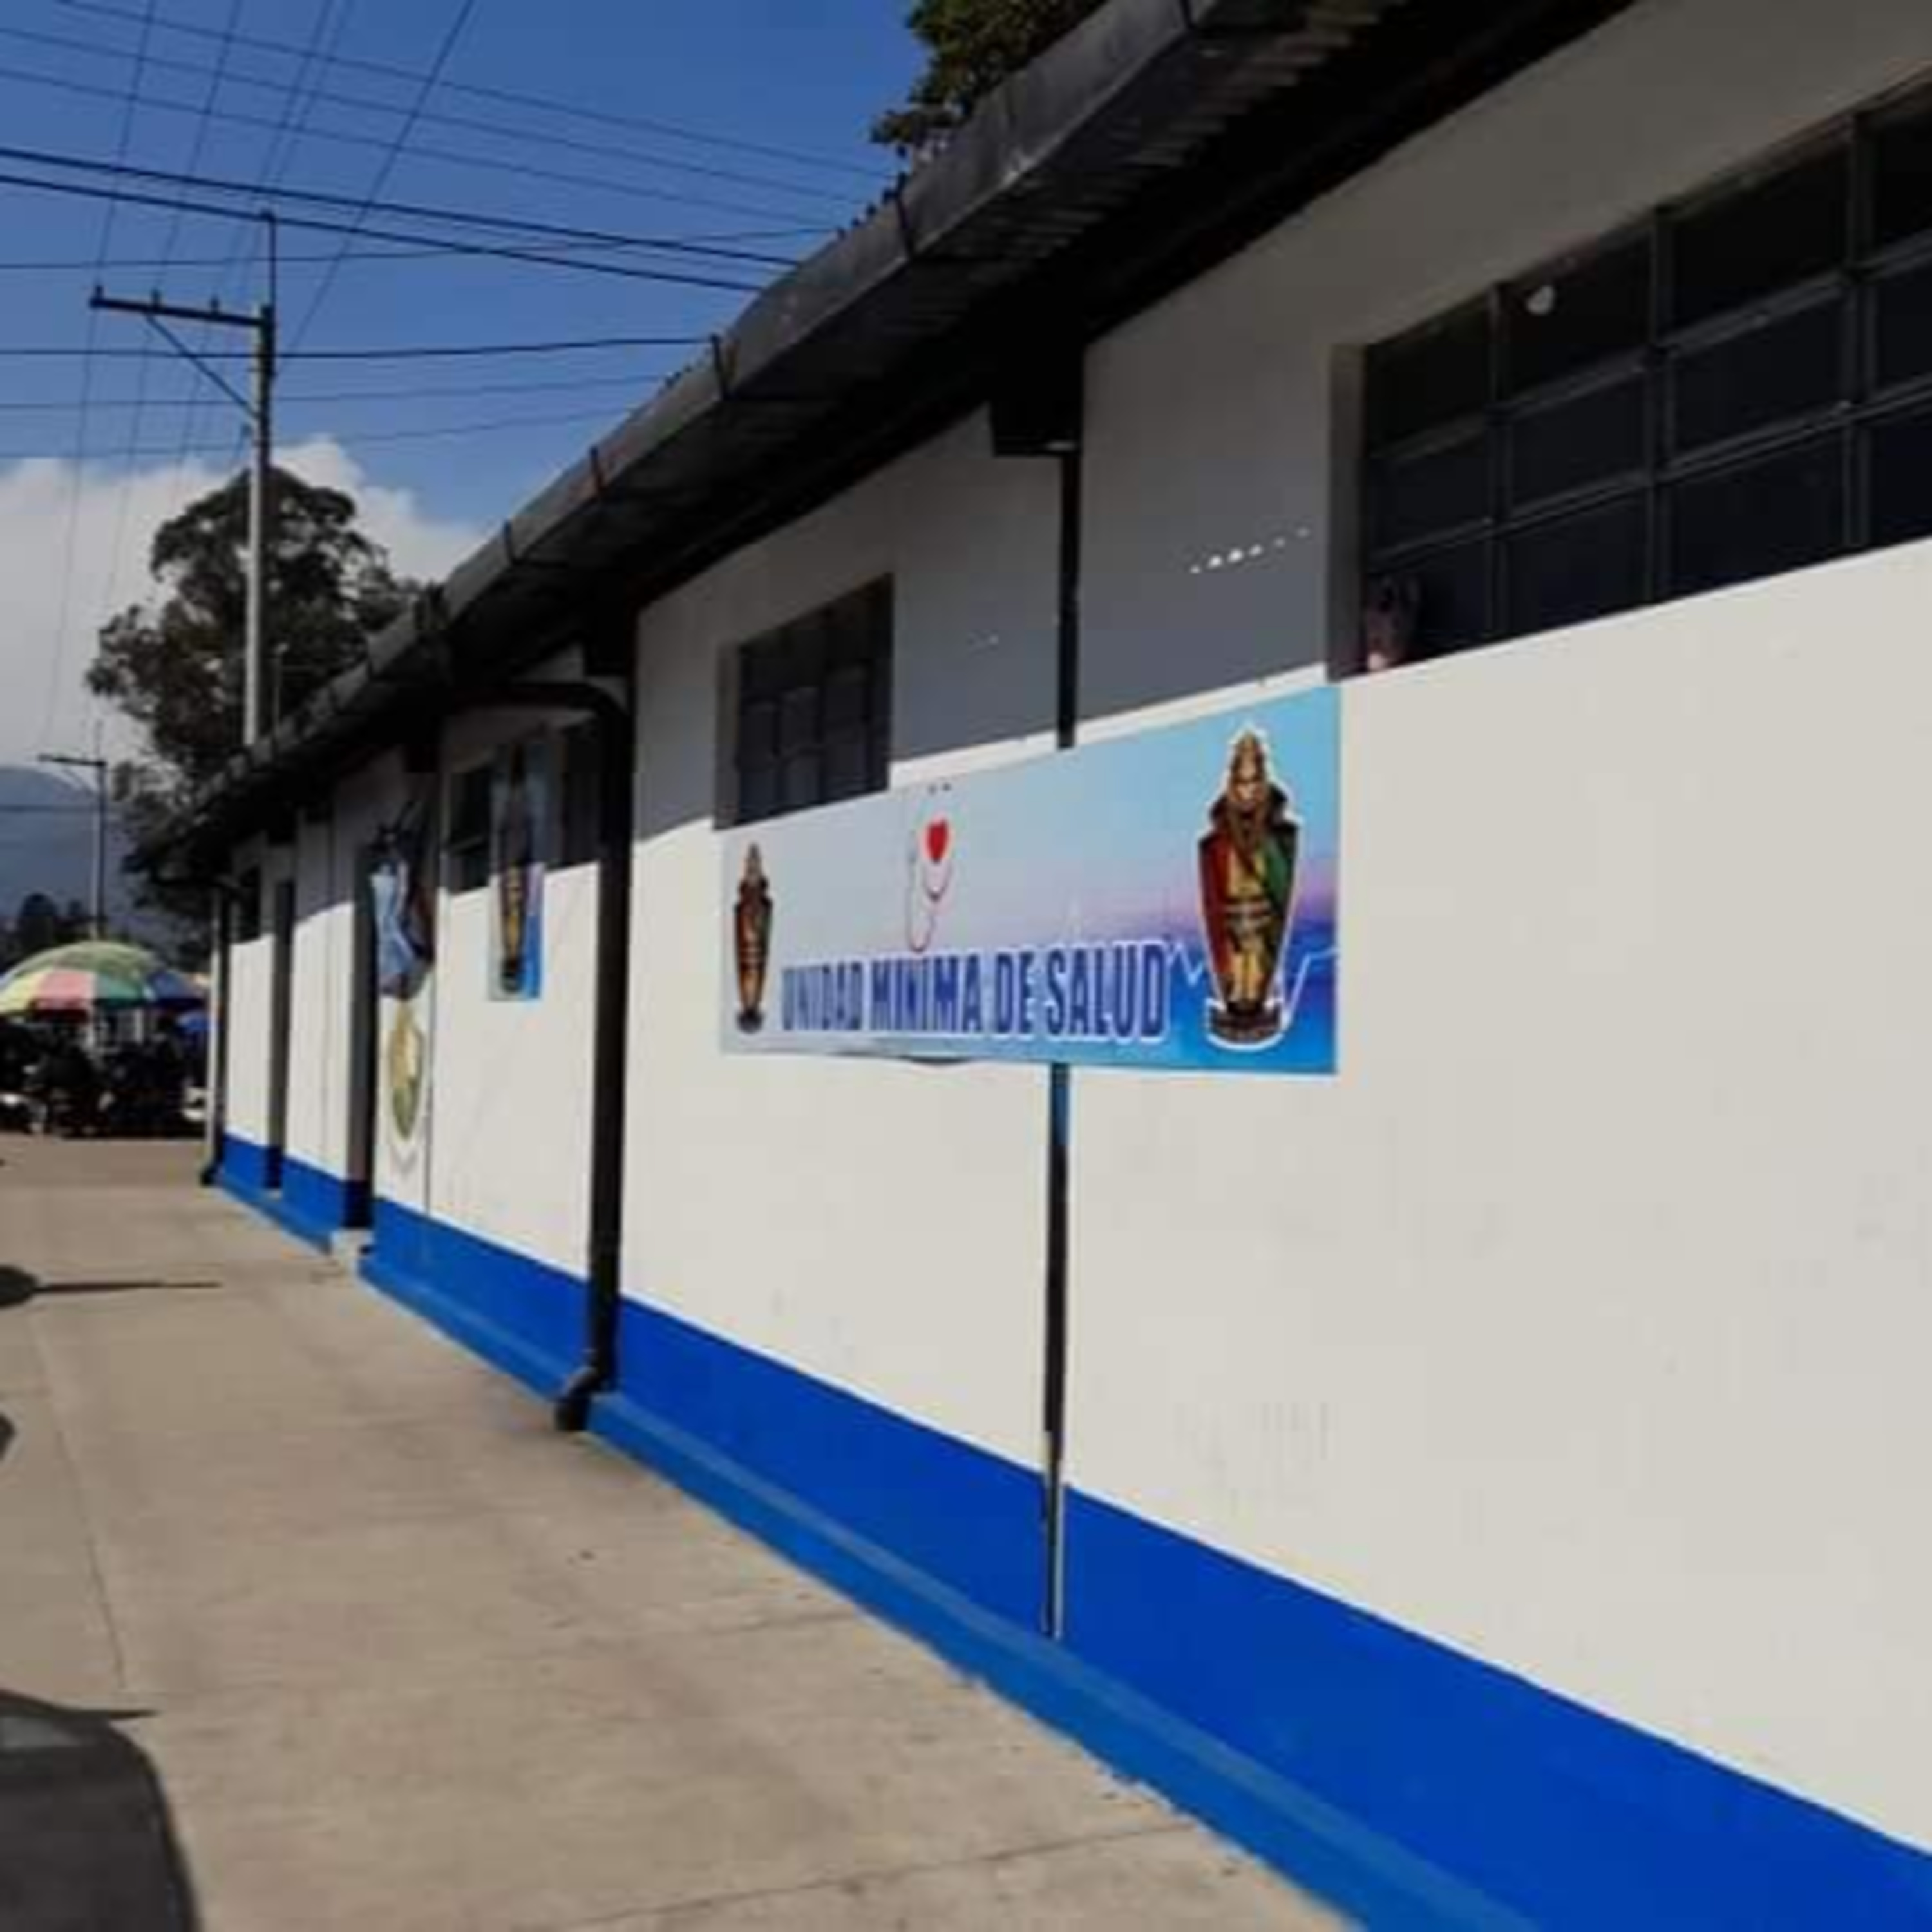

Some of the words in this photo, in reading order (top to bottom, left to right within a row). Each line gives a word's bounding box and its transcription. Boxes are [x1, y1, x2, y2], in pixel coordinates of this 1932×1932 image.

[781, 962, 863, 1032] UNIDAD
[870, 953, 983, 1034] MINIMA
[994, 949, 1034, 1036] DE
[1045, 940, 1166, 1038] SALUD
